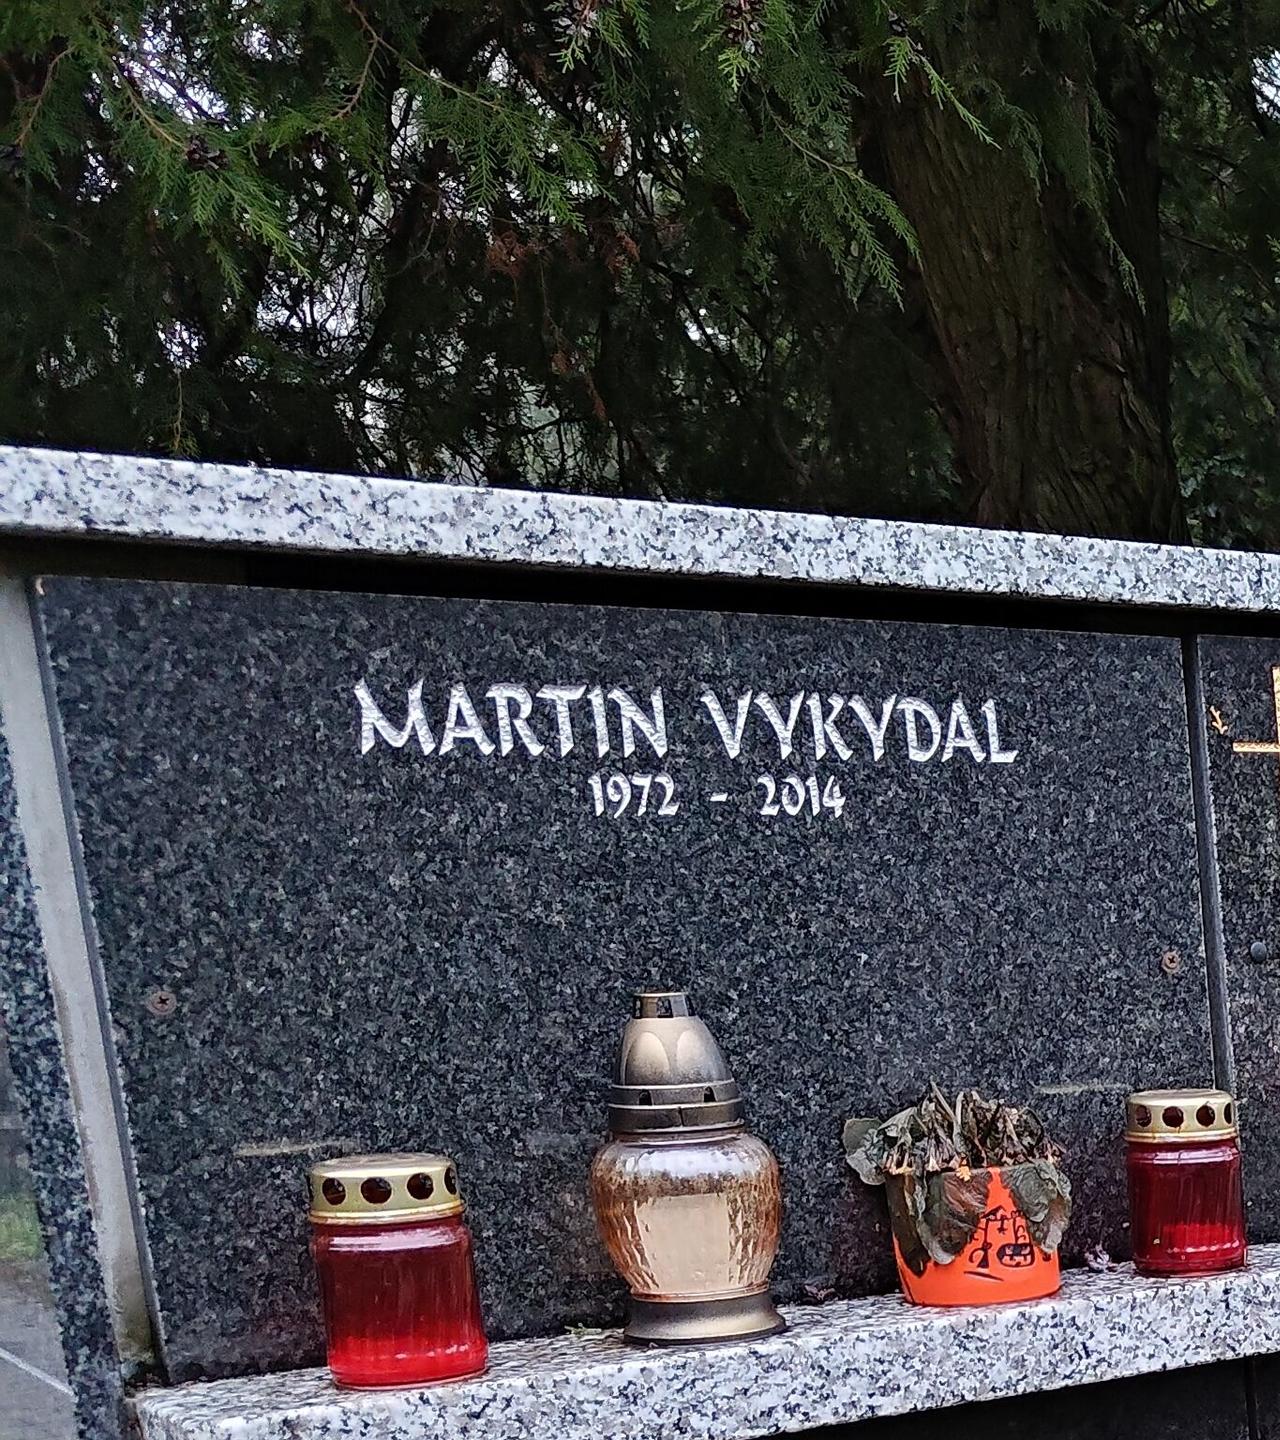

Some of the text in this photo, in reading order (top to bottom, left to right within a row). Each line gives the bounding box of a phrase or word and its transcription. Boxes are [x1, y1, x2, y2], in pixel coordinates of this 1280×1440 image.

[354, 679, 1018, 766] MARTIN VYKYDAL
[589, 775, 681, 819] 1972
[756, 773, 846, 818] 2014
